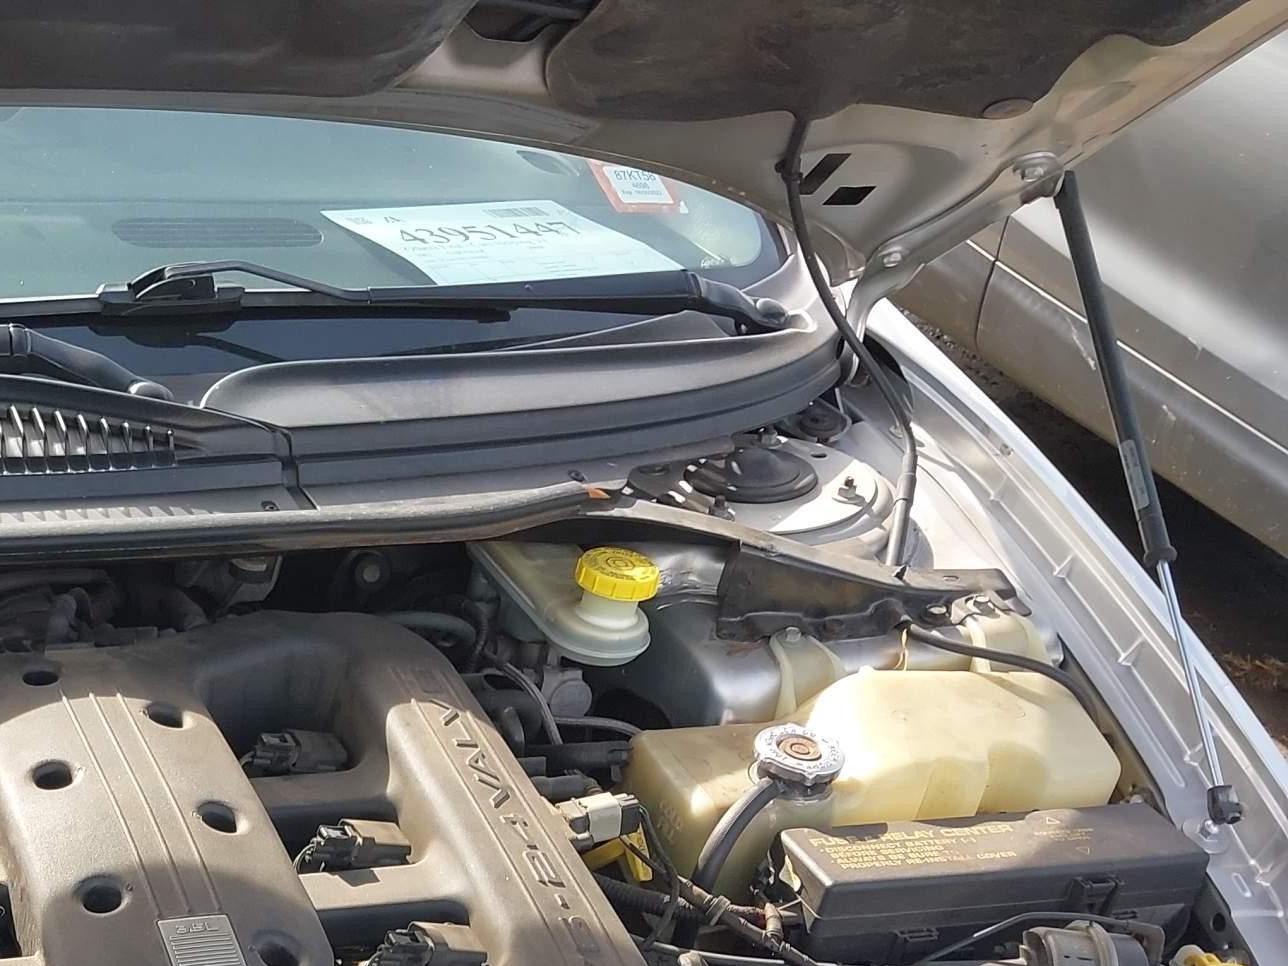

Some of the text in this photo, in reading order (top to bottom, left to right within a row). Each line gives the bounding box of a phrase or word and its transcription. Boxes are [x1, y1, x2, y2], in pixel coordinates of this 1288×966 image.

[399, 221, 581, 245] 43951447
[878, 829, 936, 842] RELAY
[940, 823, 1014, 837] CENTER
[976, 850, 1017, 860] COVER
